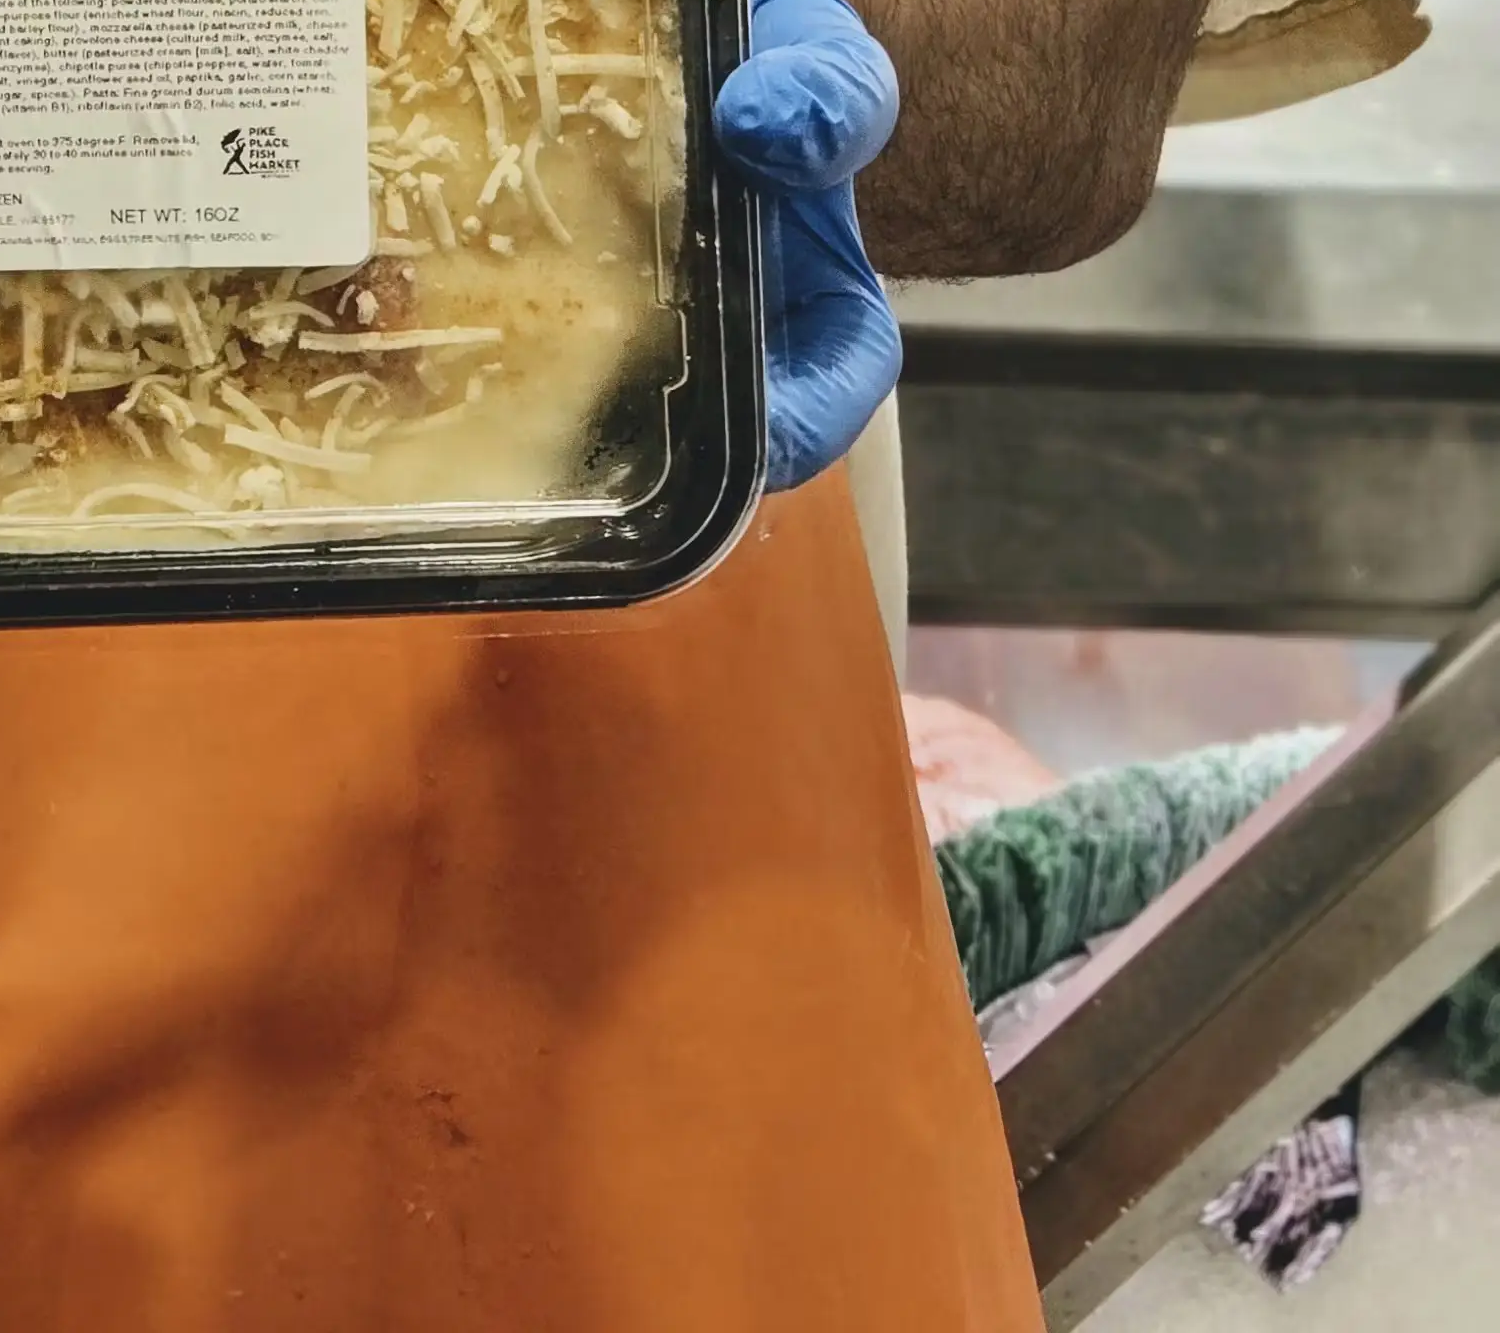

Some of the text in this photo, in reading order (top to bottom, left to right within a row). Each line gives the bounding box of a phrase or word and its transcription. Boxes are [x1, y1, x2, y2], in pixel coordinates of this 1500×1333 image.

[124, 35, 164, 43] cheese
[44, 49, 78, 59] butter
[123, 87, 148, 98] Fine
[151, 87, 192, 99] ground
[196, 87, 234, 96] durum
[249, 127, 275, 136] PIKE
[38, 139, 49, 147] to
[52, 136, 73, 147] 375
[76, 137, 115, 148] degree
[131, 135, 180, 144] Remove
[249, 138, 289, 147] PLACE
[32, 149, 47, 160] 30
[50, 151, 60, 159] to
[63, 149, 78, 157] 40
[80, 146, 128, 158] minutes
[130, 148, 156, 157] until
[250, 149, 275, 158] FISH
[249, 160, 300, 169] MARKET
[8, 166, 54, 175] serving.
[110, 209, 146, 224] NET
[154, 208, 187, 223] WT:
